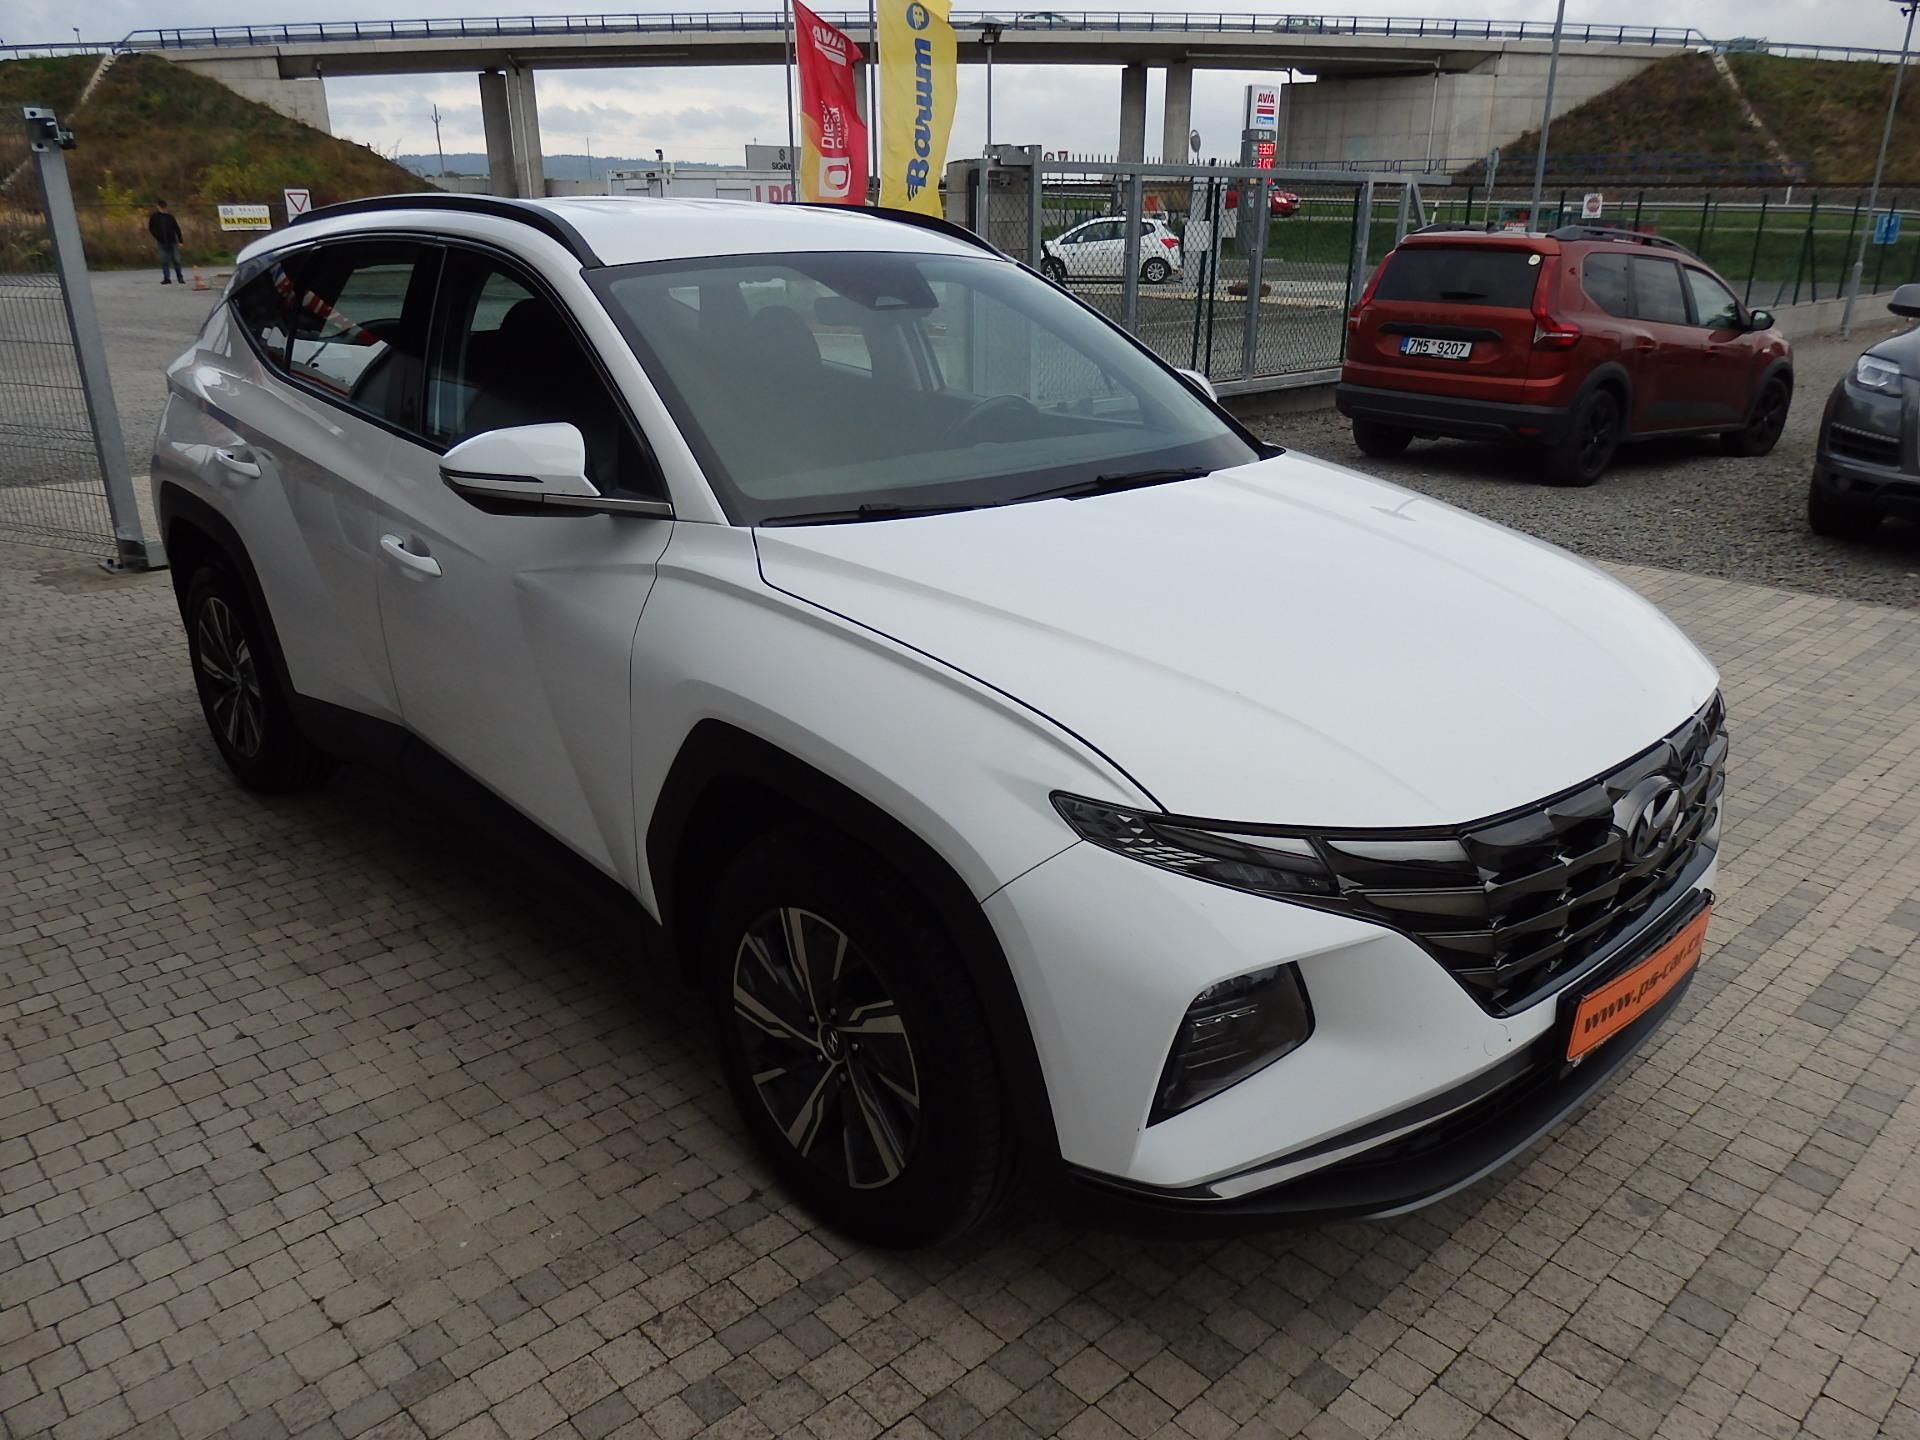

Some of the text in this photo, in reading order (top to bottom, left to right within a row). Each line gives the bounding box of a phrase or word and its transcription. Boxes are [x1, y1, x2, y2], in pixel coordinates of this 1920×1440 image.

[906, 38, 934, 202] Barum
[1408, 339, 1467, 356] 7M5 9207
